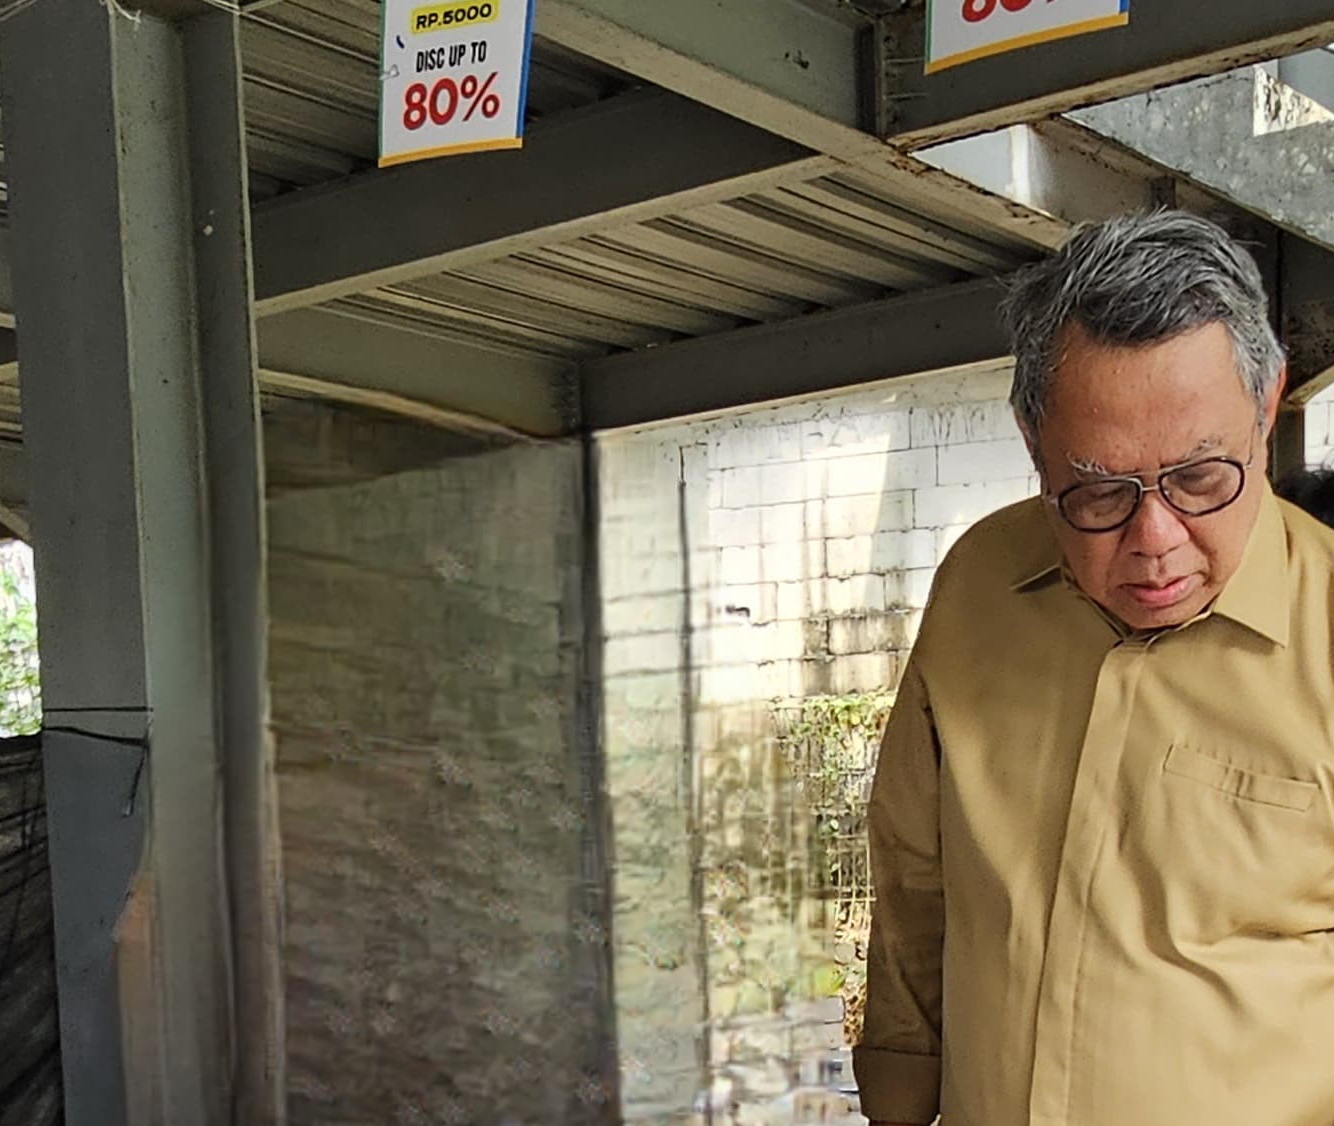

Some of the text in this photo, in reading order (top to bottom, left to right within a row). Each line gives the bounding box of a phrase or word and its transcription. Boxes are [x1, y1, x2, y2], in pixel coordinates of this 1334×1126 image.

[416, 3, 492, 30] RP.5000
[416, 41, 487, 72] DISC UP TO
[403, 72, 500, 130] 80%
